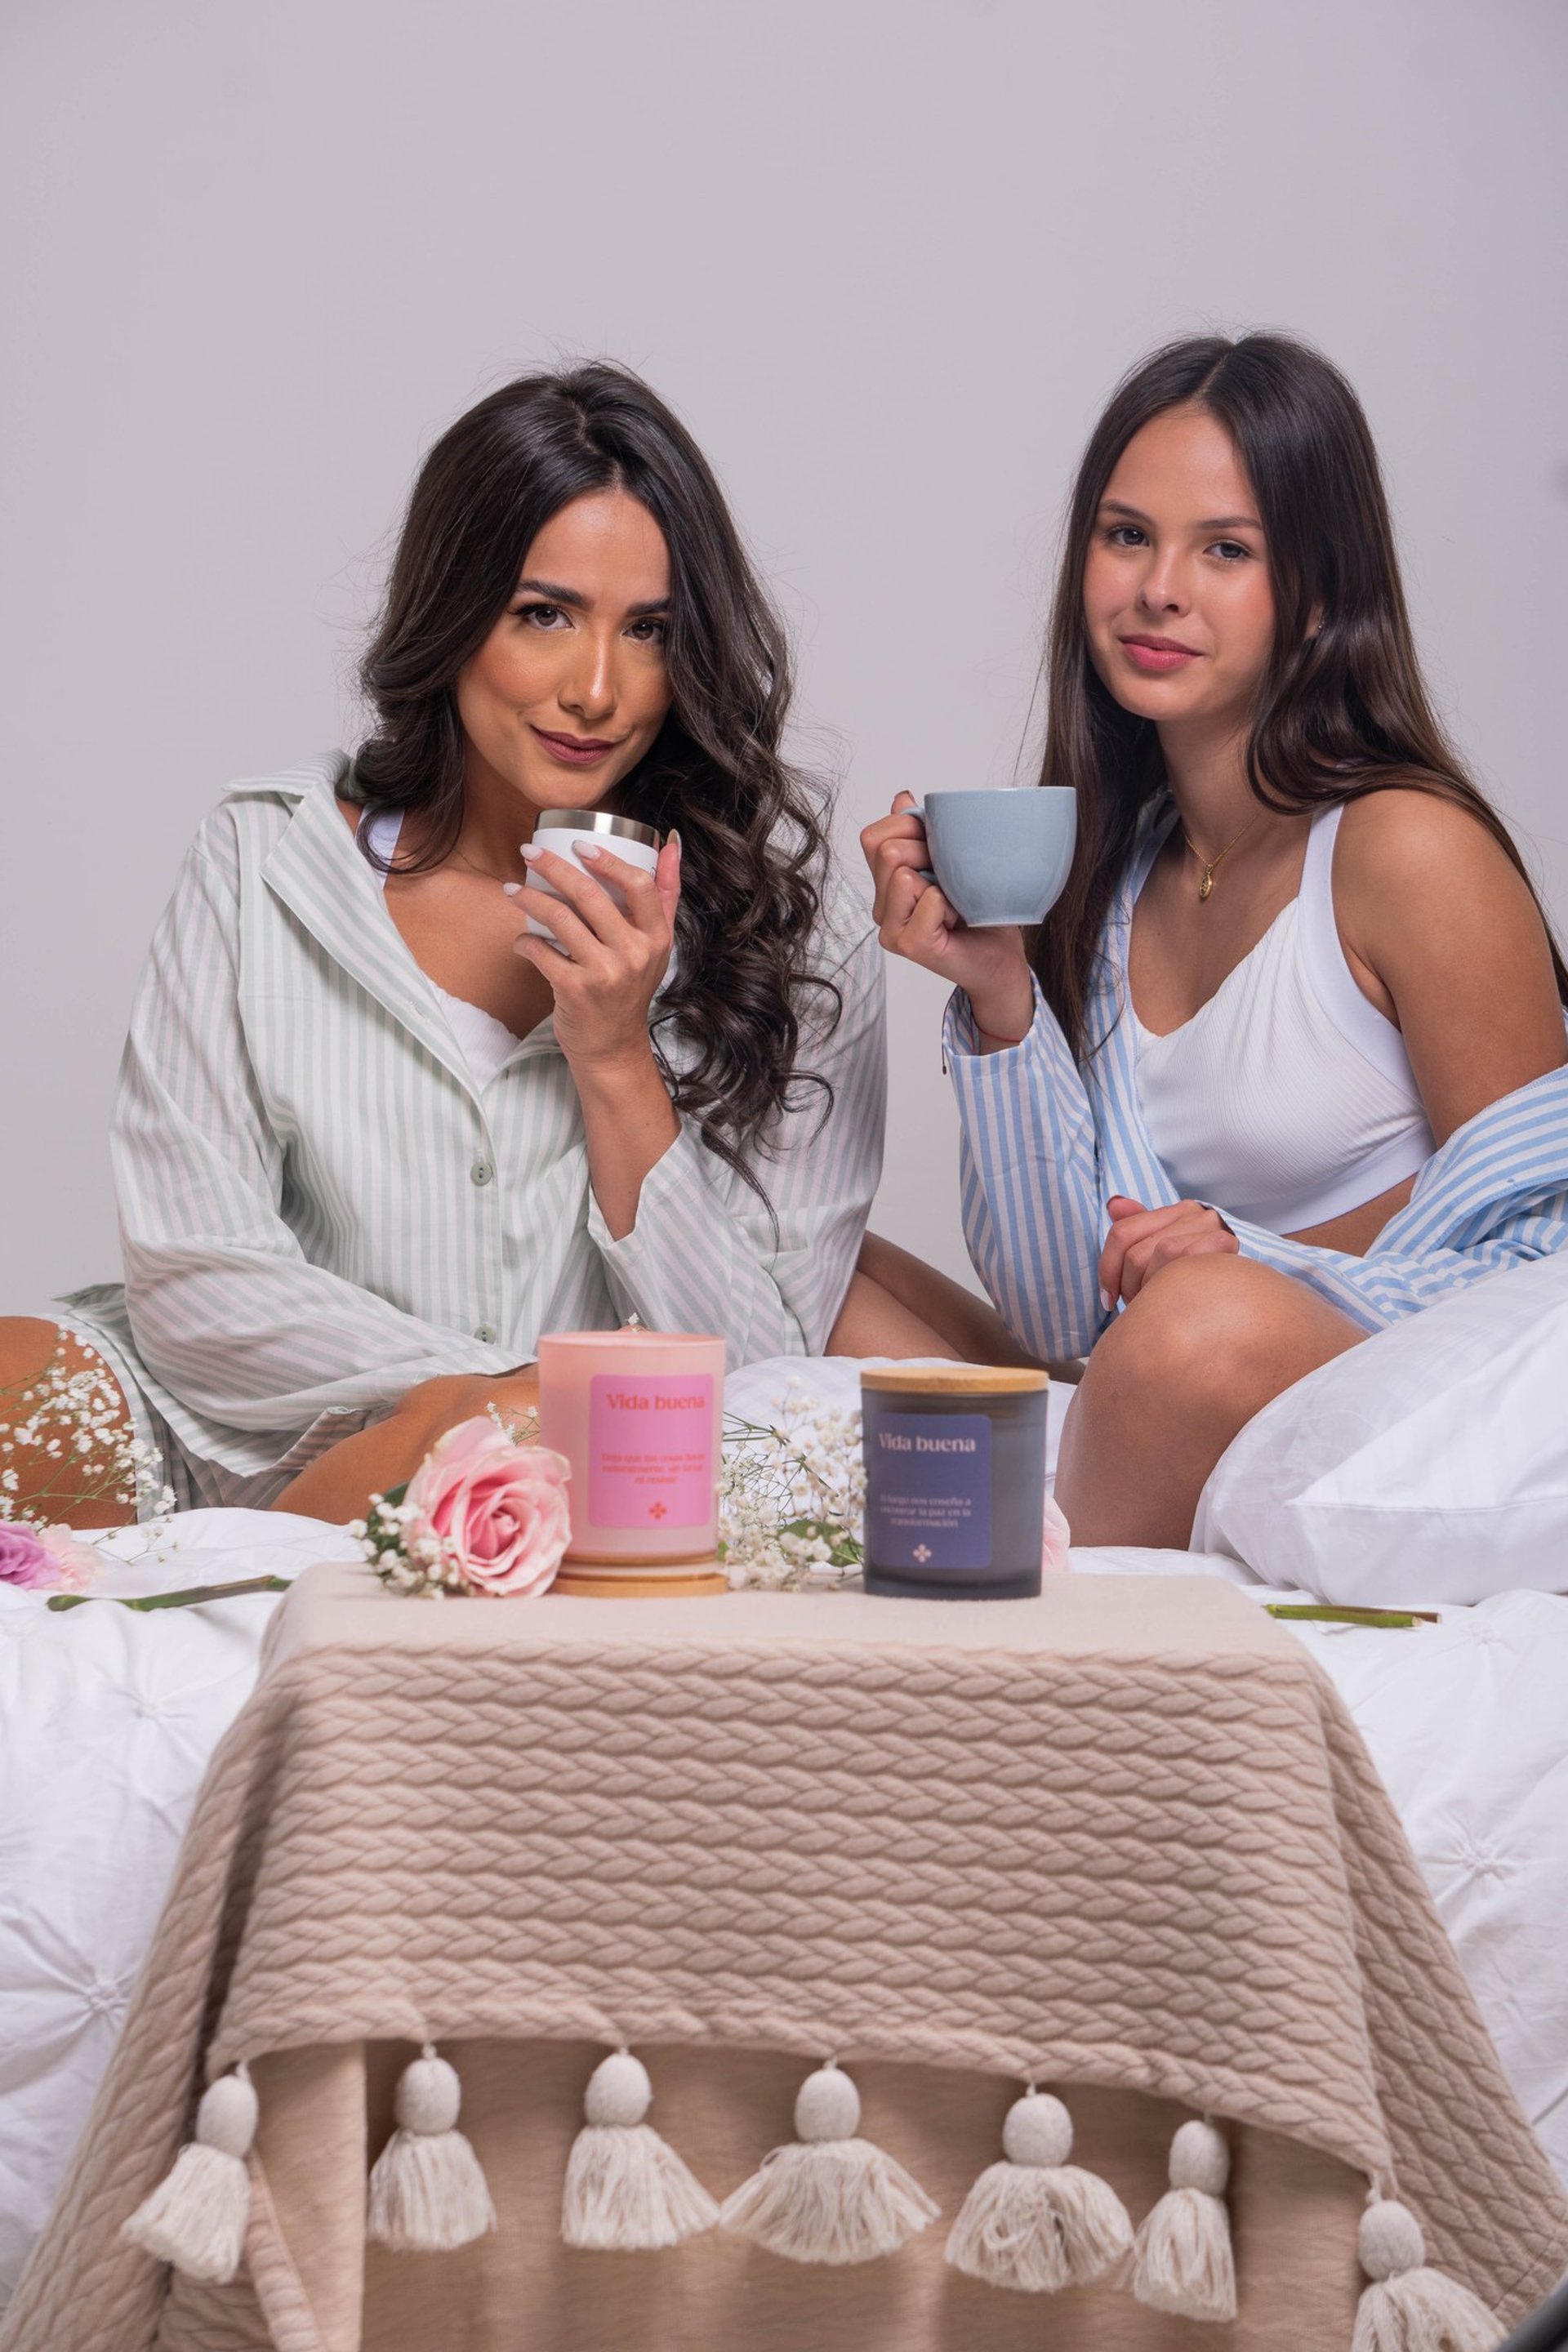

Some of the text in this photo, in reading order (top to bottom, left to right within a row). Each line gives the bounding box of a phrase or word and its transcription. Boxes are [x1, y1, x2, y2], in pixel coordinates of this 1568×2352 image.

[606, 1392, 706, 1410] Vida buena
[878, 1432, 976, 1451] Vida buena
